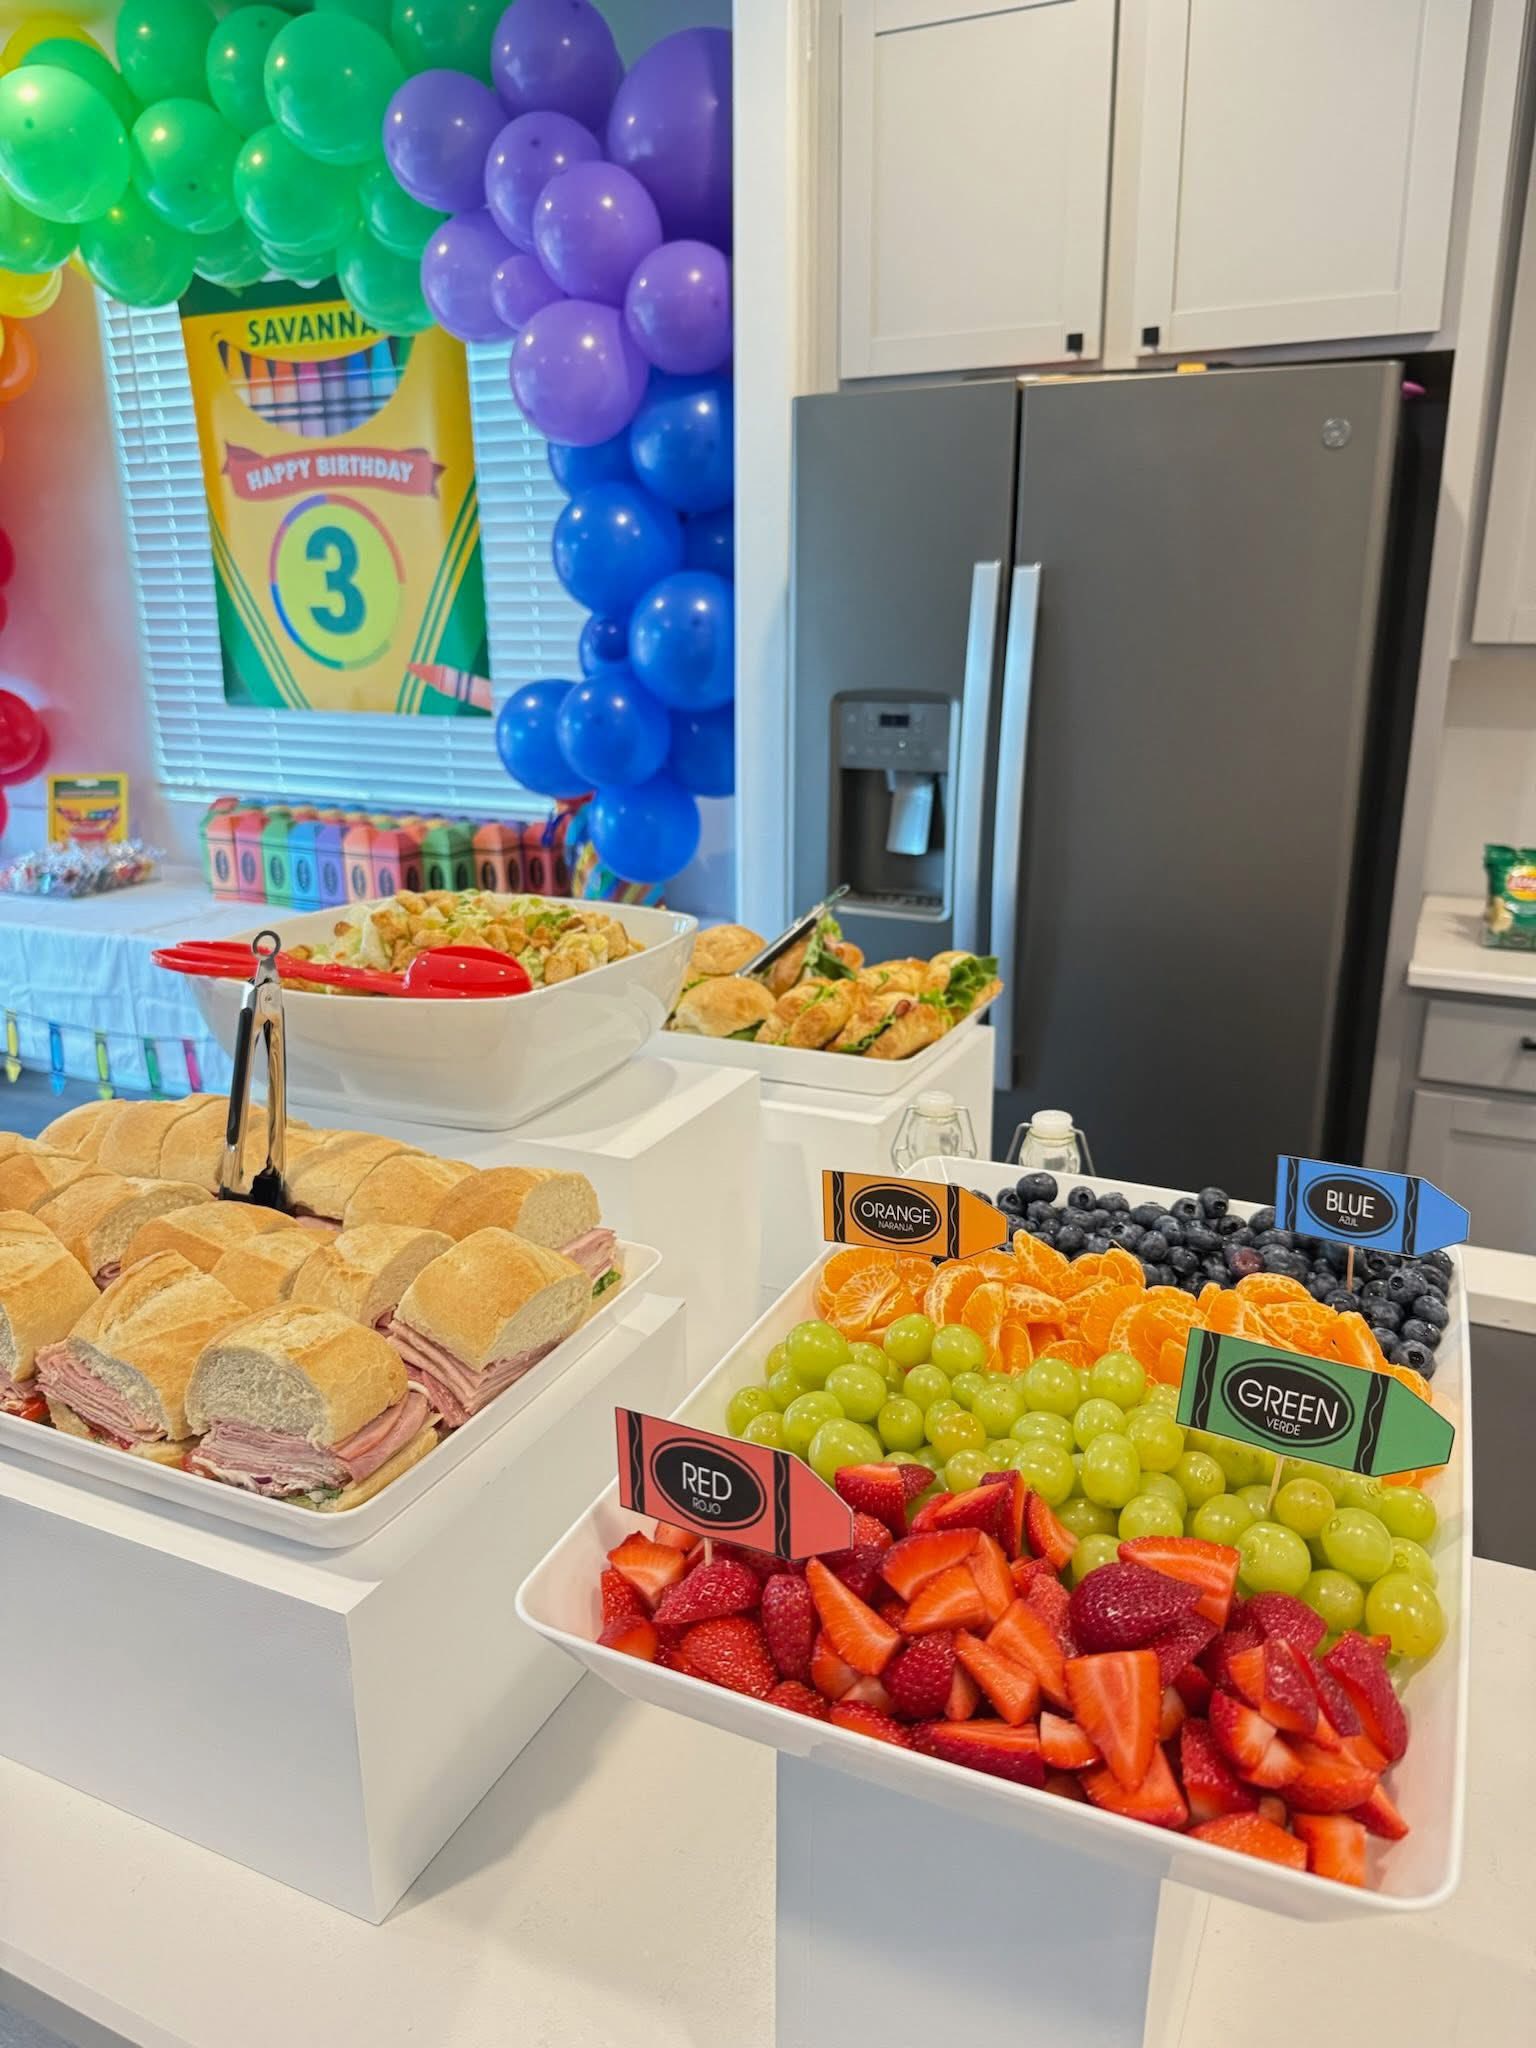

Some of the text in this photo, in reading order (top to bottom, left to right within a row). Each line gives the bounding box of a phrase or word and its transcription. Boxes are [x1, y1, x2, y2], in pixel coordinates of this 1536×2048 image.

[248, 311, 378, 347] SAVANNA
[246, 454, 413, 491] HAPPY BIRTHDAY
[305, 525, 366, 636] 3
[860, 1201, 932, 1225] ORANGE
[1326, 1190, 1376, 1219] BLUE
[878, 1221, 914, 1232] NARANJA
[1338, 1215, 1359, 1227] AZUL
[1238, 1379, 1339, 1429] GREEN
[1266, 1416, 1301, 1436] VERDE
[682, 1461, 732, 1501] RED
[692, 1497, 721, 1515] ROJO
